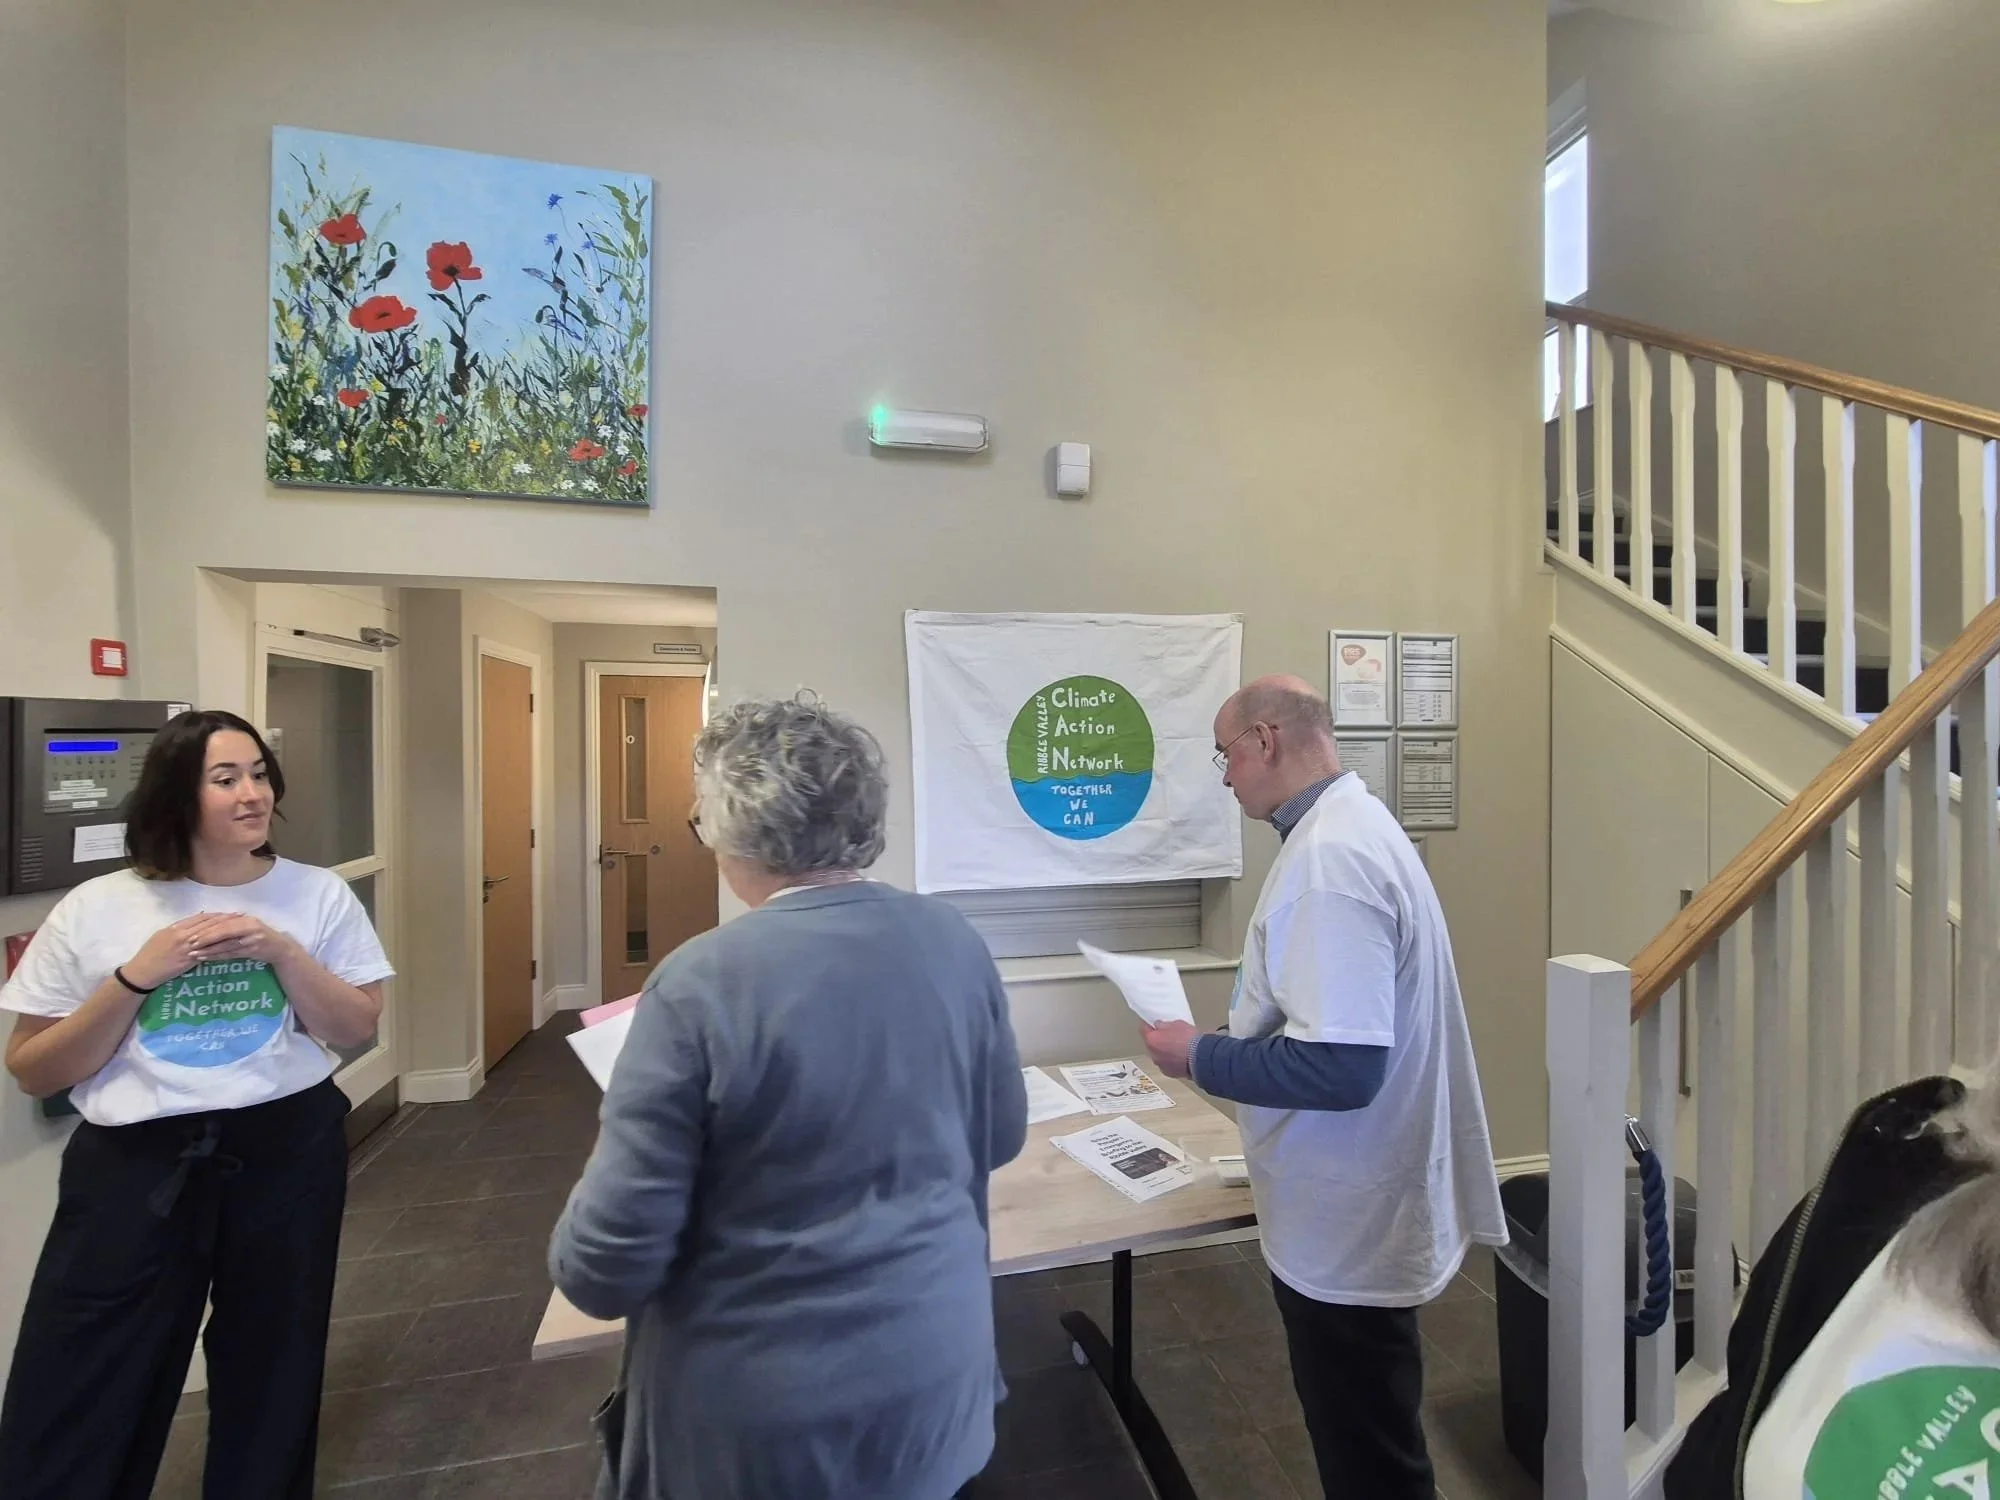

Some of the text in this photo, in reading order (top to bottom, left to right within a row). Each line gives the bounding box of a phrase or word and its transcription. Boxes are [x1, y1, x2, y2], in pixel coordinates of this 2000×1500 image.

[1051, 687, 1116, 708] Climate
[1035, 695, 1048, 774] RIBBLE VALLEY
[1054, 714, 1115, 737] Action
[1052, 746, 1124, 771] Network
[1051, 784, 1112, 796] TOGETHER
[1069, 798, 1088, 811] WE
[1063, 812, 1094, 826] CAN
[175, 980, 249, 999] Action
[174, 992, 273, 1019] Network
[1916, 1384, 1977, 1450] VALLEY
